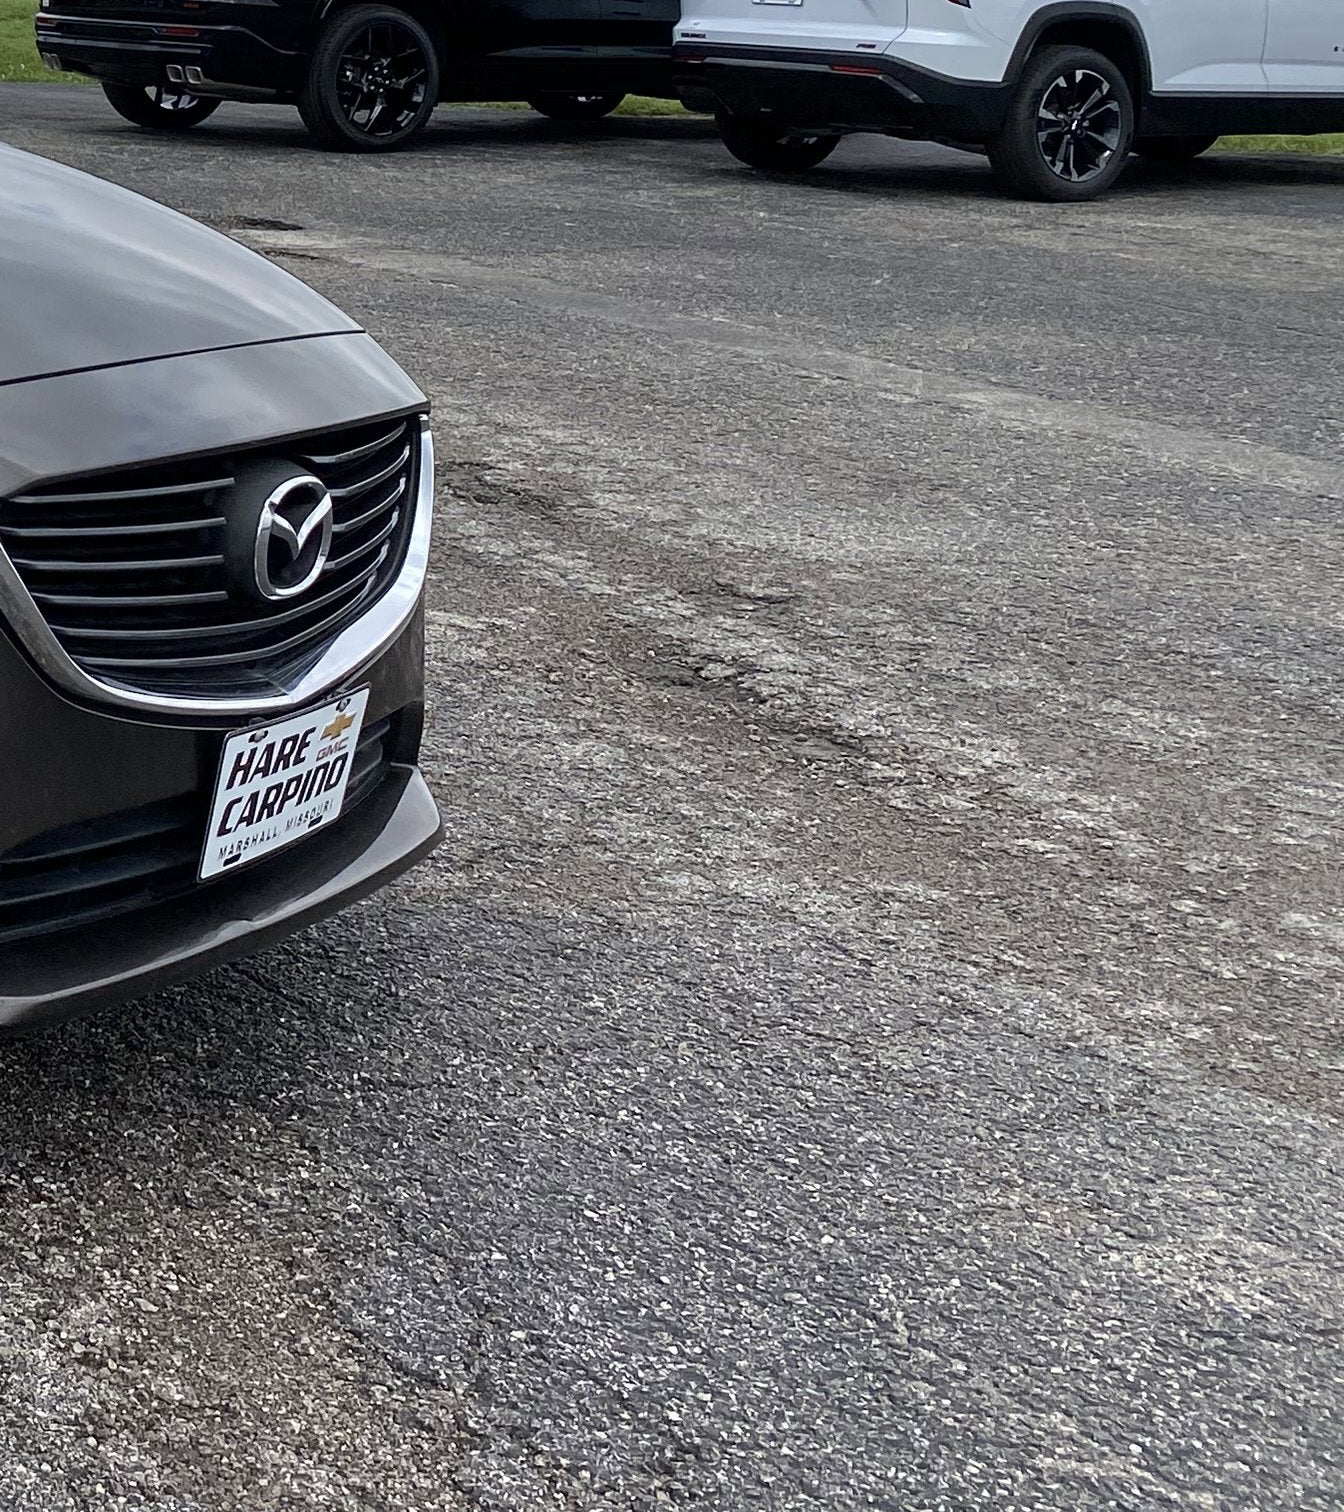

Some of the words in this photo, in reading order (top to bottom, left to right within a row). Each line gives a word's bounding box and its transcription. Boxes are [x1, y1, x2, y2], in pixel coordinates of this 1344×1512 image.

[224, 726, 317, 792] HARE
[315, 736, 350, 763] GMC
[216, 751, 349, 838] CARPINO
[285, 799, 334, 832] MISSOURI
